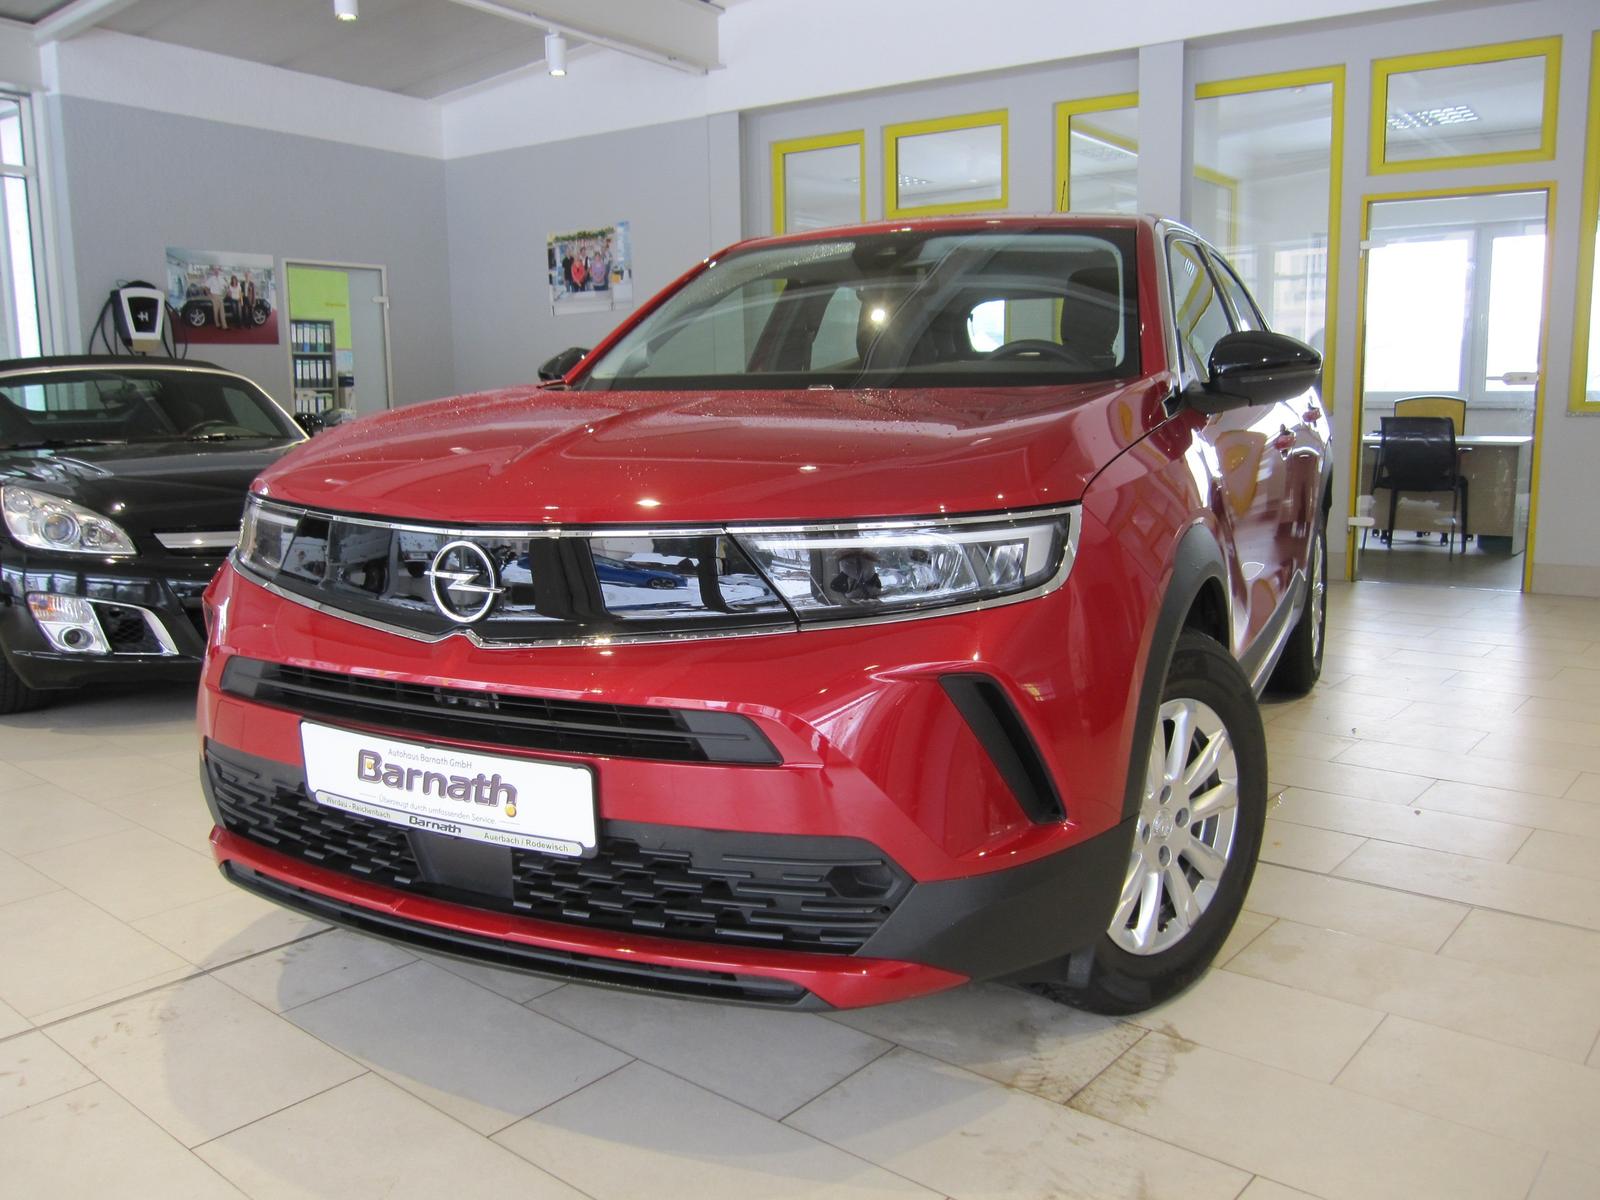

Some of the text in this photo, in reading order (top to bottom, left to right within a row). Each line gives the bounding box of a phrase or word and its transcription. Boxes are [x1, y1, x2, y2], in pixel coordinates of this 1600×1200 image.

[388, 748, 472, 769] Autohaus Barnath GmbH
[357, 748, 518, 810] Barnath
[352, 802, 391, 818] Reichenbach
[408, 815, 461, 834] Barnath
[484, 832, 519, 845] Auerbach
[525, 839, 568, 852] Rodewisch
